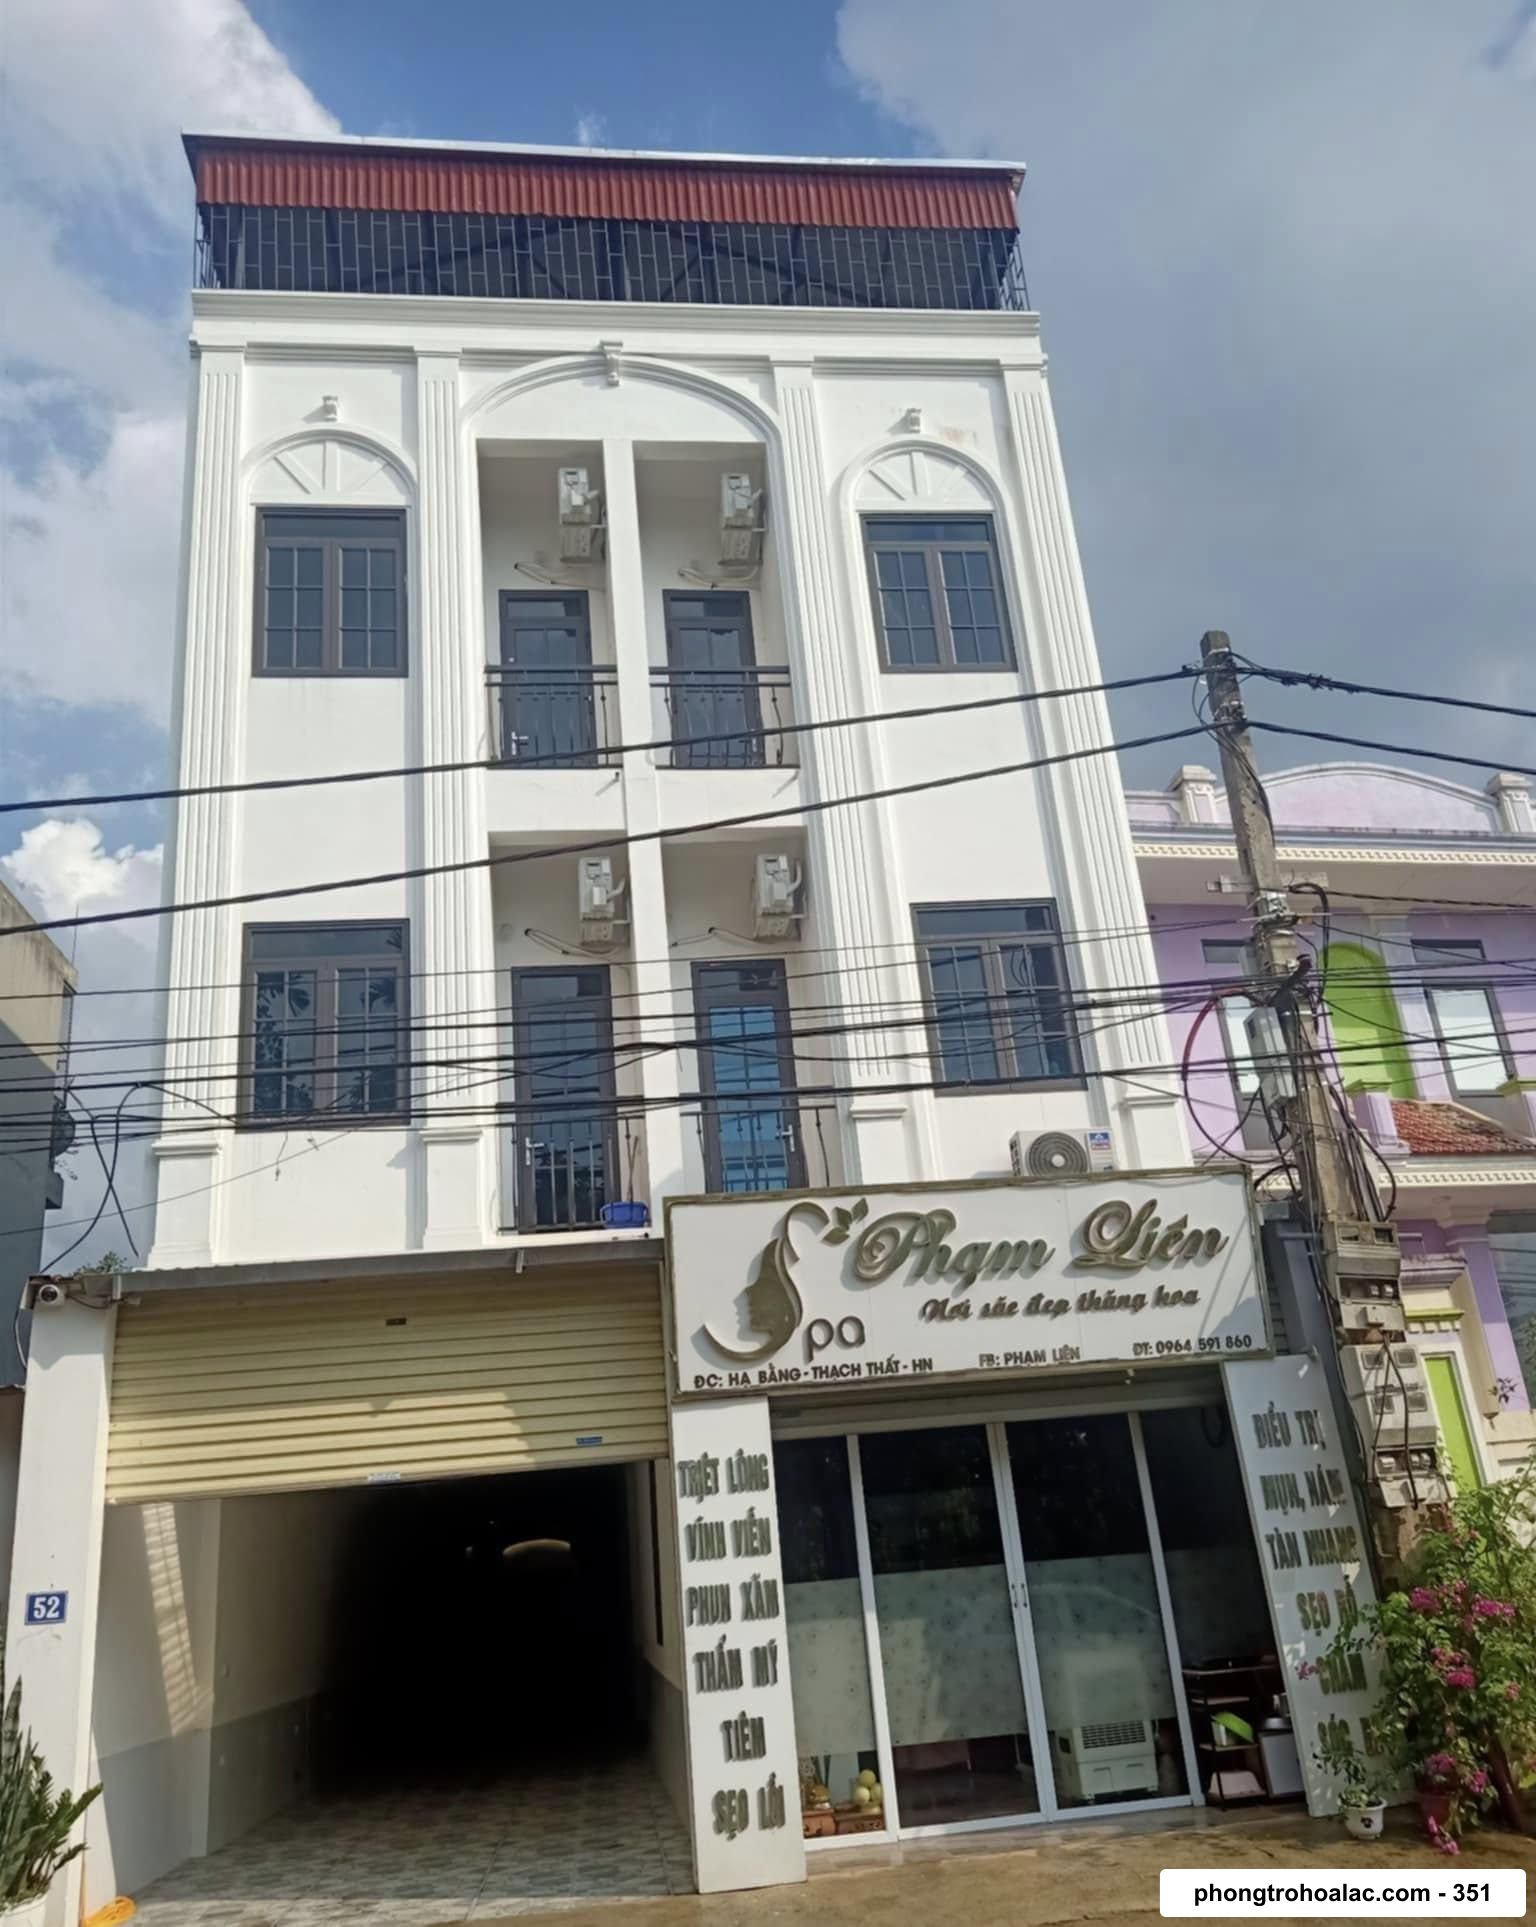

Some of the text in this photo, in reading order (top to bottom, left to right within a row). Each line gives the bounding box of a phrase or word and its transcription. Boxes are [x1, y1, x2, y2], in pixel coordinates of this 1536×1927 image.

[856, 1208, 1056, 1288] Phạm
[1076, 1289, 1148, 1315] thăng
[1152, 1285, 1199, 1308] hoa
[979, 1353, 1000, 1367] FB:
[1052, 1345, 1080, 1361] LIÊN
[1156, 1339, 1192, 1354] 0964
[1198, 1337, 1221, 1350] 591
[1226, 1334, 1252, 1348] 860
[694, 1373, 723, 1388] ĐC:
[865, 1354, 900, 1375] THẤT
[912, 1358, 933, 1372] HN
[33, 1596, 59, 1618] 52
[686, 1584, 731, 1627] PHUN
[720, 1710, 766, 1763] TIÊM
[712, 1788, 749, 1841] SẸO
